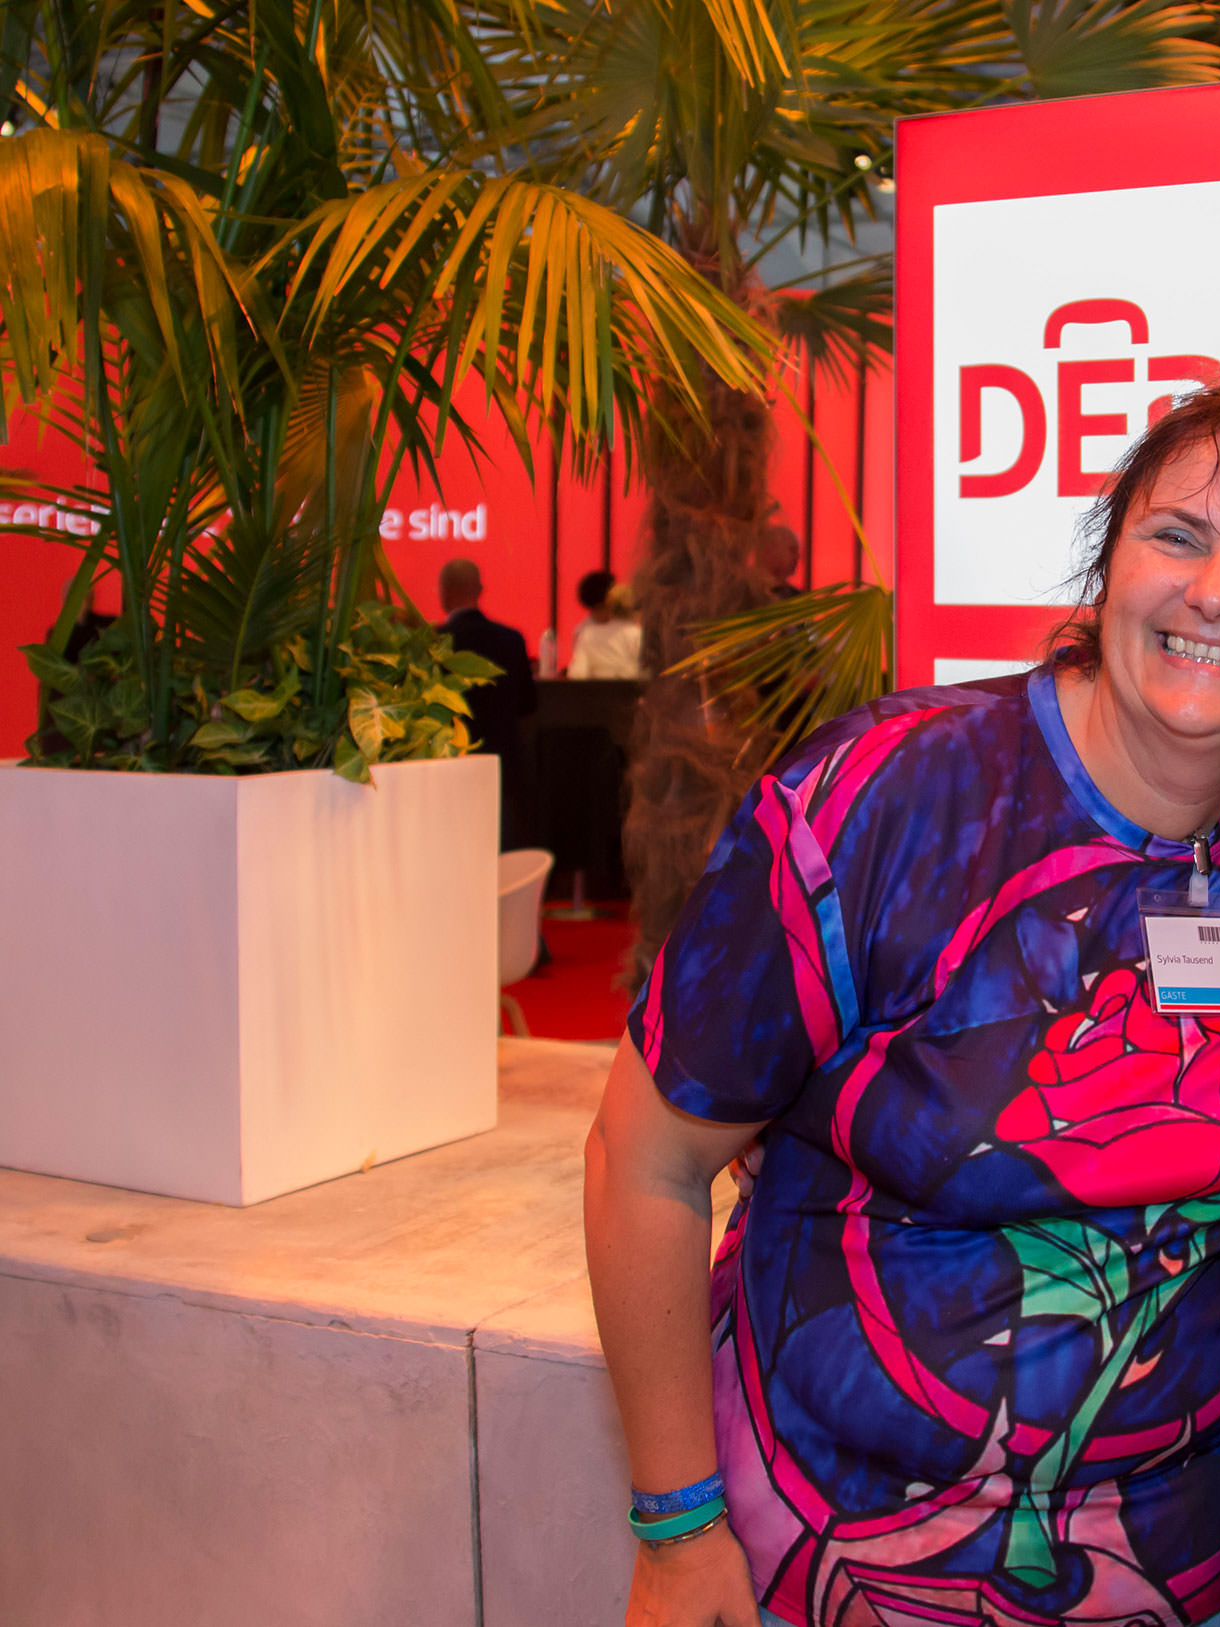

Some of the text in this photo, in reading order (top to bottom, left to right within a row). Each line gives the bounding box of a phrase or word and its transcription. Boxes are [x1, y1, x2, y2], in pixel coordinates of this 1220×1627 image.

[408, 503, 486, 541] sind
[1156, 954, 1214, 966] Sylvia Tausend
